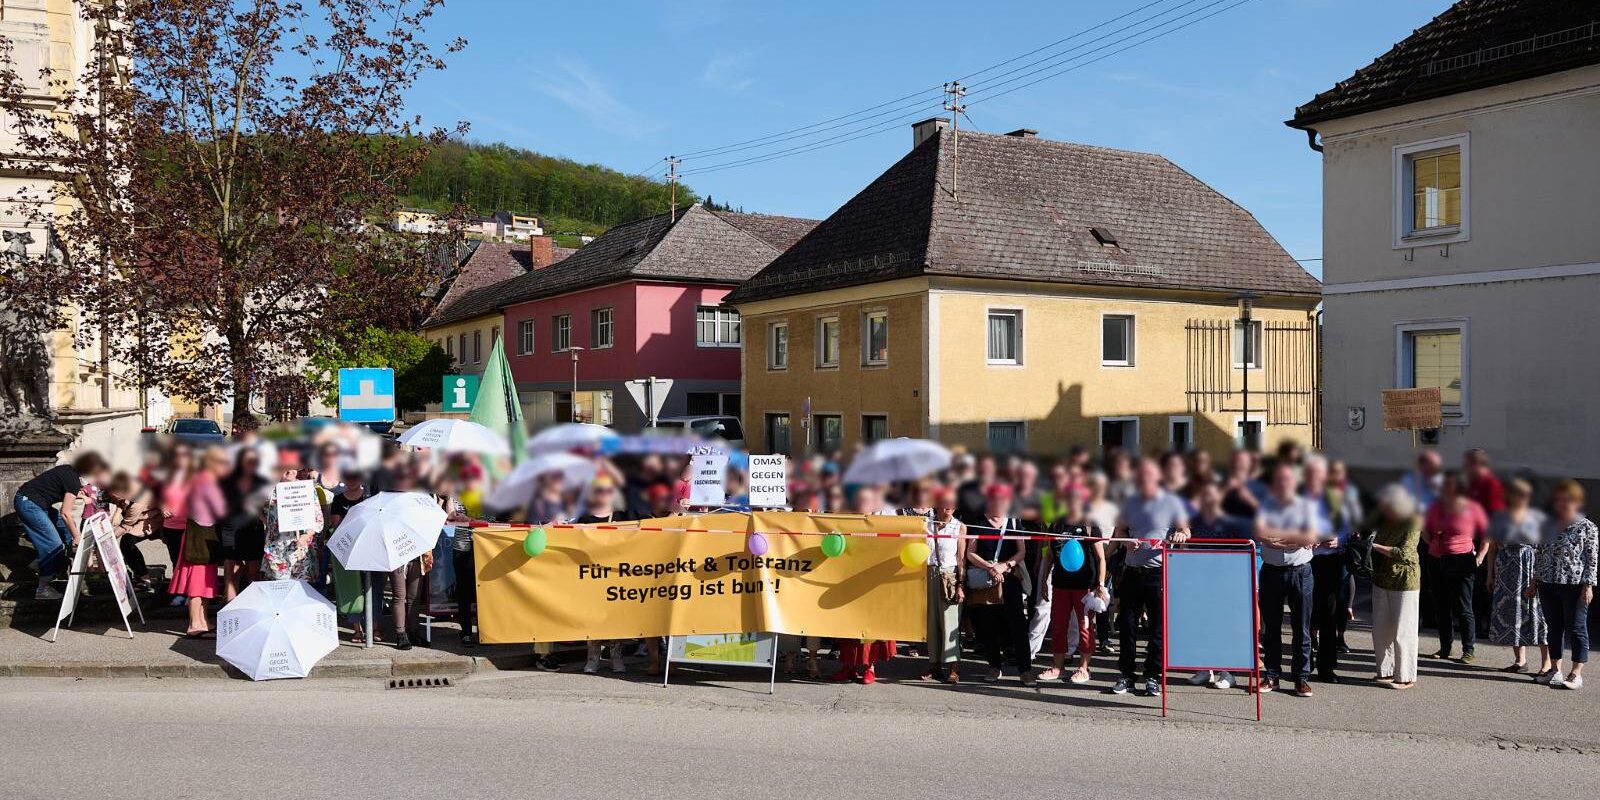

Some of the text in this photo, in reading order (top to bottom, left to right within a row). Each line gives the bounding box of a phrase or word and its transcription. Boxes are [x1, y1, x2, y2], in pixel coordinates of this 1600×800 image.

[753, 458, 782, 466] OMAS
[751, 471, 784, 479] GEGEN
[750, 485, 785, 493] RECHTS
[392, 534, 408, 545] OMAS
[395, 539, 412, 551] GEGEN
[398, 545, 417, 558] RECHTS
[579, 554, 812, 580] Für Respekt & Toleranz
[606, 578, 780, 603] Steyregg ist bun!
